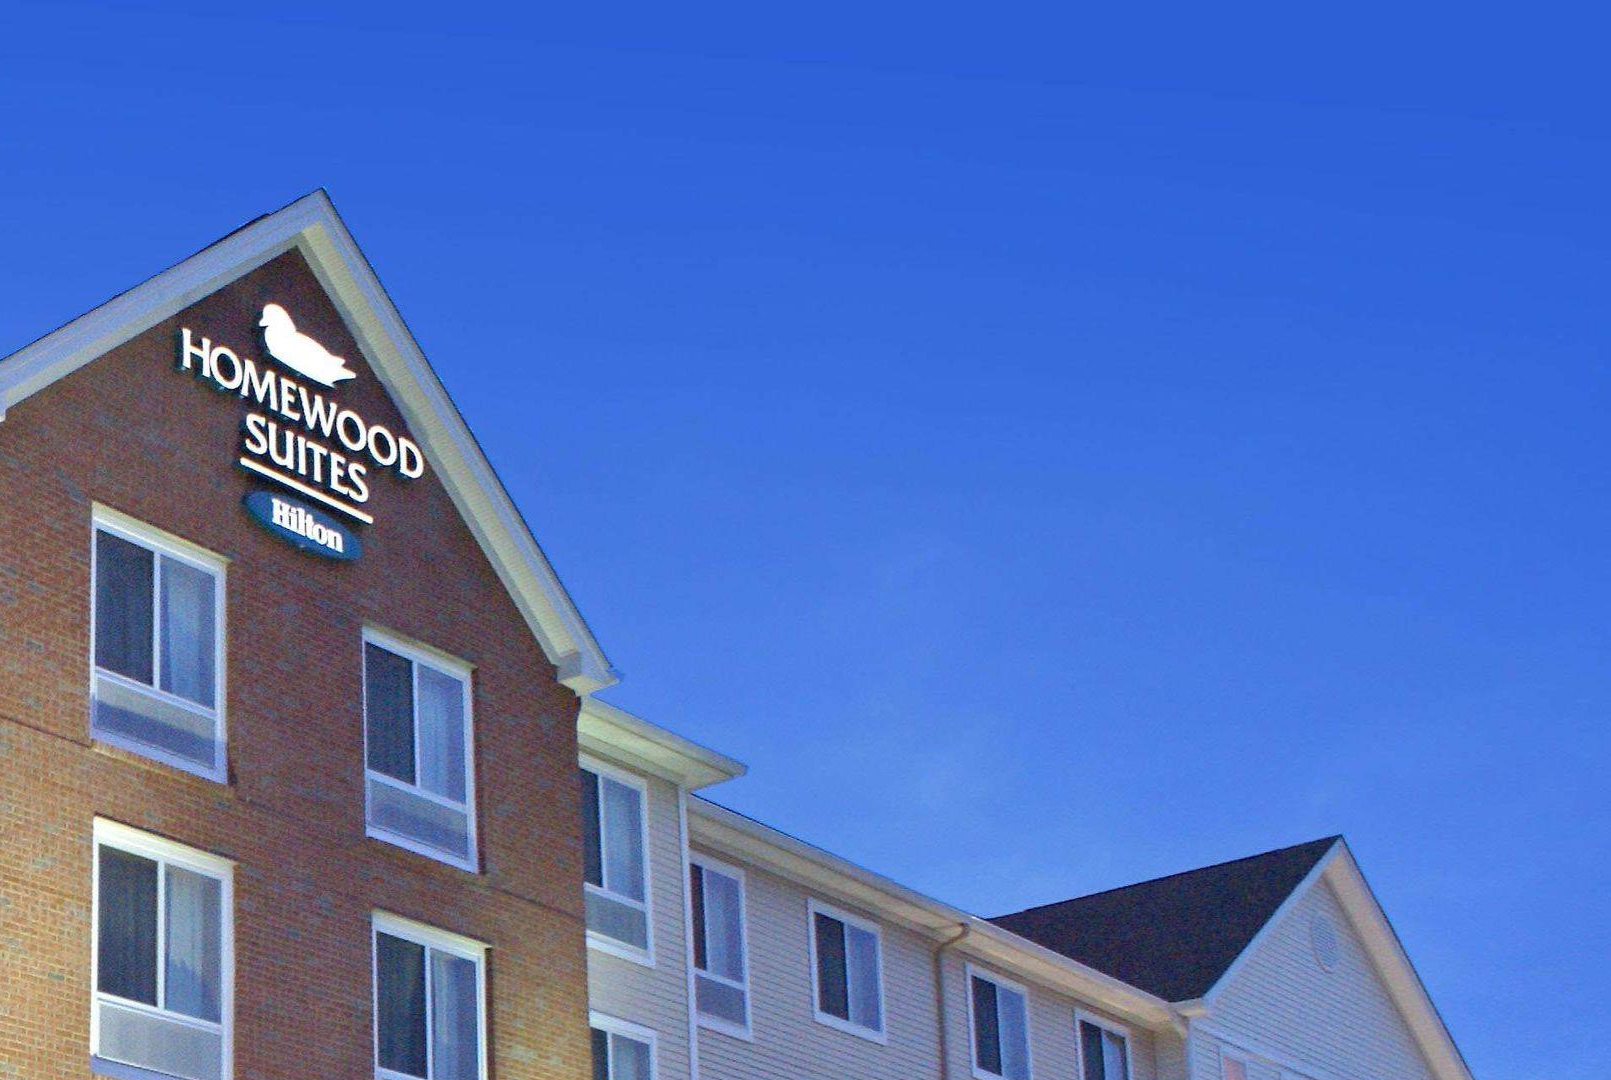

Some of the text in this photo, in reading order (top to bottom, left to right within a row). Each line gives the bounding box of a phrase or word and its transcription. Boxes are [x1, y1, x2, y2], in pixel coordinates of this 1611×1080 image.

[181, 327, 424, 479] HOMEWOOD
[244, 413, 369, 503] SUITES
[272, 498, 343, 553] Hilton
